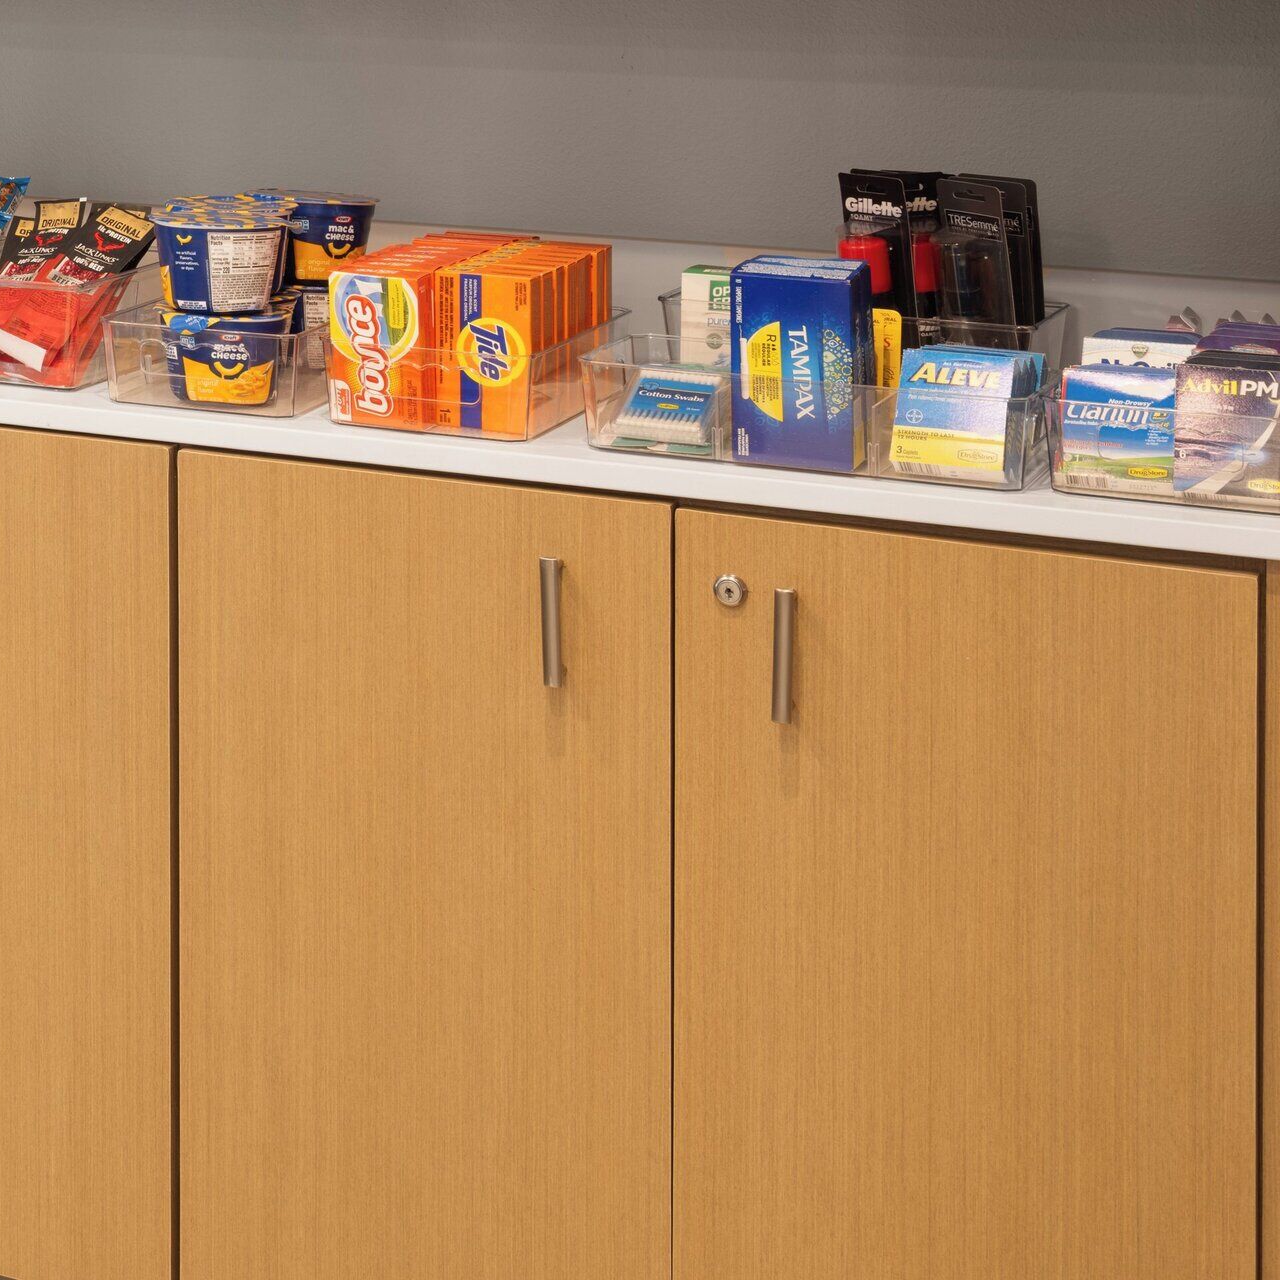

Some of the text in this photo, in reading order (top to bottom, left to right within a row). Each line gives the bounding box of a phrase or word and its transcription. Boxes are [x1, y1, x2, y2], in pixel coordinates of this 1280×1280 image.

[845, 197, 902, 218] Gillette
[42, 217, 76, 228] ORIGINAL
[101, 215, 142, 240] ORIGINAL
[947, 212, 999, 233] TRESemmé
[106, 228, 132, 244] PROTEIN
[75, 242, 95, 257] JACK
[73, 255, 105, 272] 100% BEEF
[347, 296, 389, 415] bounce
[468, 322, 510, 382] Tide
[788, 325, 816, 420] TAMPAX
[910, 362, 1003, 389] ALEVE
[637, 388, 705, 403] Cotton Swabs
[1181, 377, 1279, 399] Advil PM
[1108, 397, 1152, 408] Non-Drowsy
